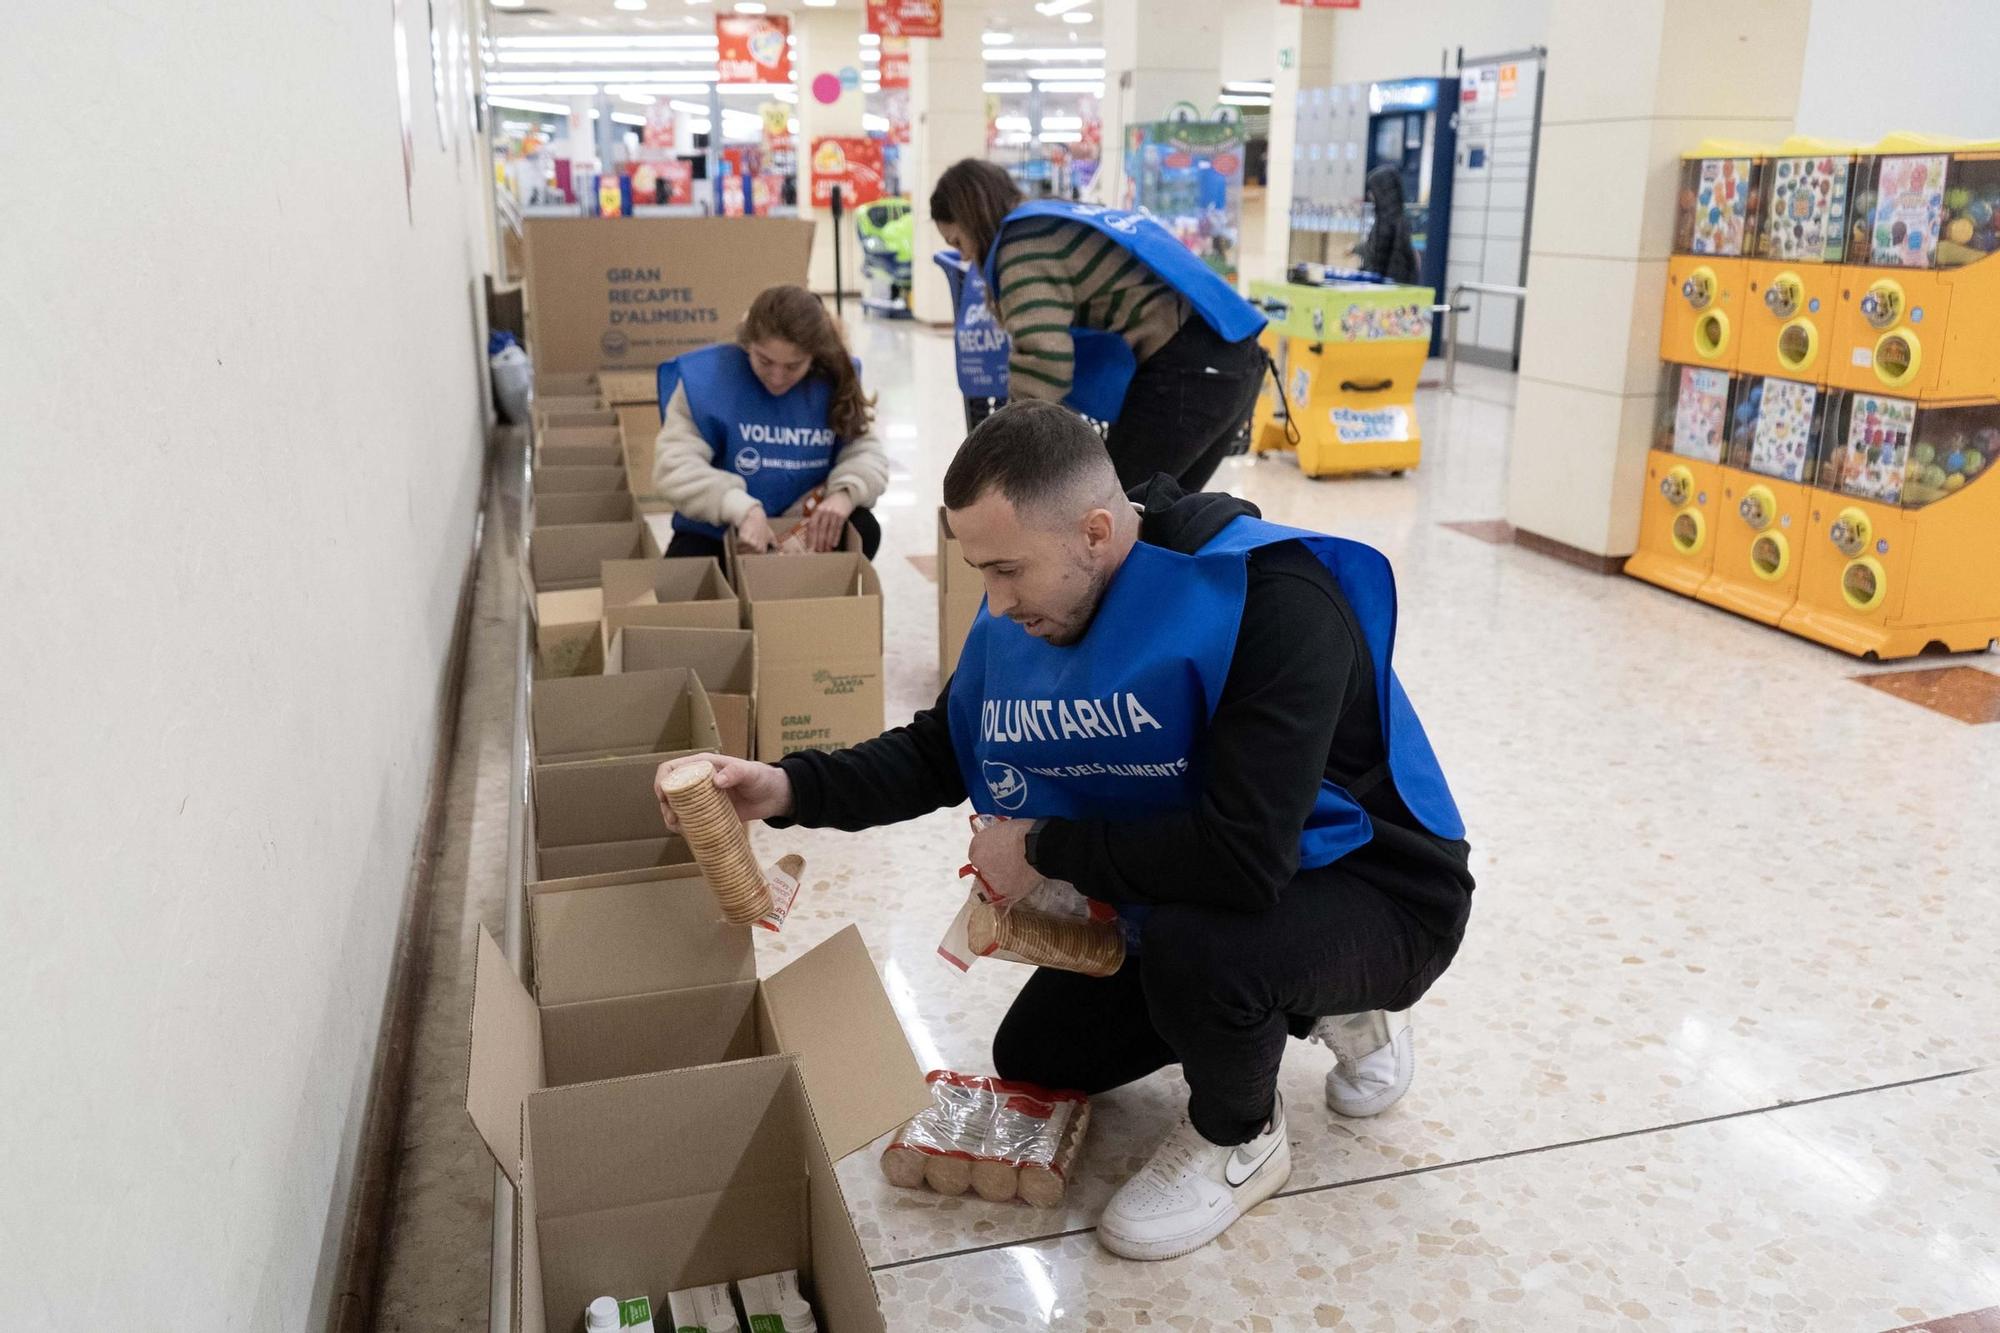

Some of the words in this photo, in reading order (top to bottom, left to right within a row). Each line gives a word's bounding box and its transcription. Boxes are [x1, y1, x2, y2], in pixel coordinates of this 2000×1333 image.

[607, 266, 661, 282] GRAN
[608, 287, 692, 303] RECAPTE
[609, 307, 718, 325] D'ALIMENTS
[739, 423, 837, 446] VOLUNTAR
[781, 715, 811, 727] GRAN
[782, 728, 831, 741] RECAPTE
[1069, 762, 1107, 777] DELS
[1107, 757, 1189, 777] ALIMENTS
